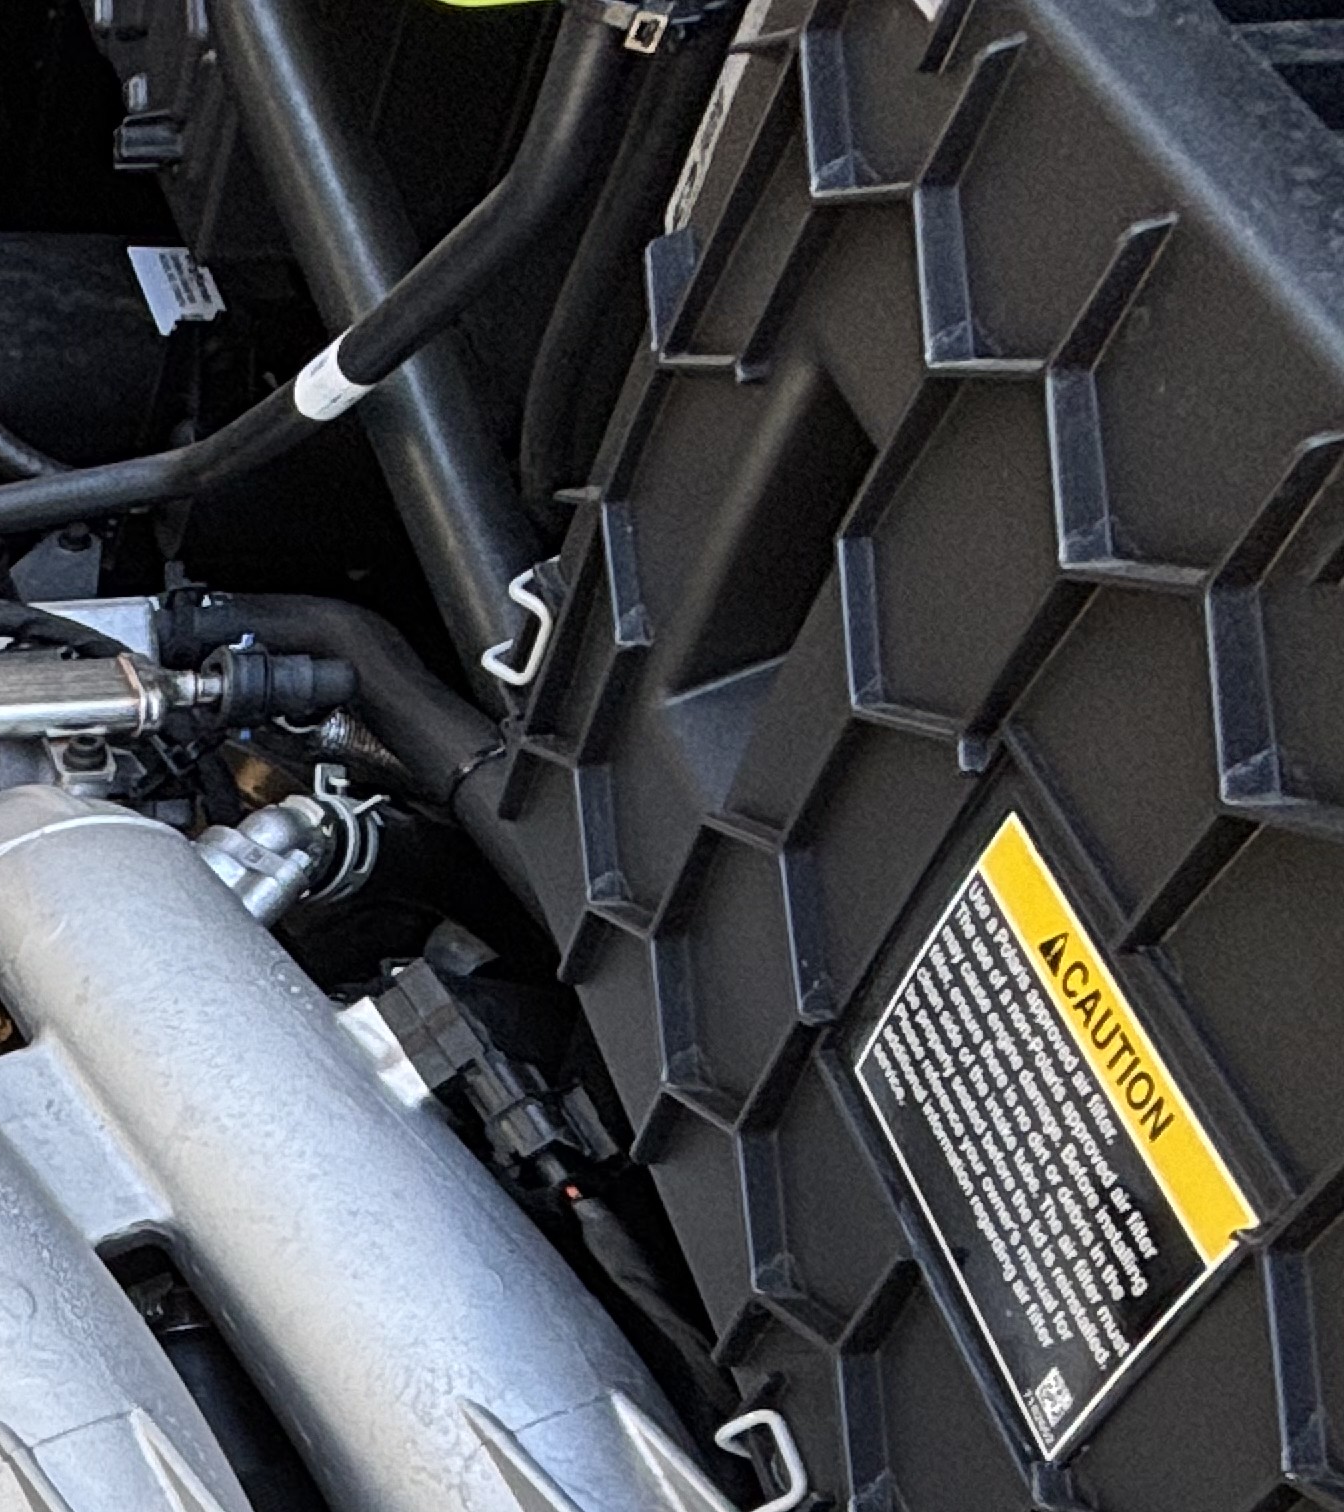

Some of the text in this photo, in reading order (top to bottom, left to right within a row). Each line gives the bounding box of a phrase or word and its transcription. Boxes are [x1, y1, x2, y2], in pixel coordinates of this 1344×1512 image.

[873, 1043, 905, 1105] service.
[905, 983, 920, 1010] be
[915, 1009, 956, 1077] properly
[952, 1075, 987, 1135] seated
[982, 1131, 1015, 1191] before
[1011, 1189, 1033, 1223] the
[1028, 1219, 1049, 1248] lid
[1041, 1245, 1055, 1267] is
[942, 925, 1147, 1296] may cause engine damage. Before installing
[950, 987, 983, 1044] ensure
[980, 1040, 1008, 1088] there
[1004, 1084, 1018, 1107] is
[1013, 1105, 1031, 1132] no
[1027, 1131, 1051, 1165] dirt
[1045, 1164, 1063, 1185] or
[1057, 1187, 1094, 1247] debris
[1090, 1242, 1106, 1267] in
[1102, 1265, 1124, 1301] the
[955, 901, 1157, 1258] The use of a non-Polaris approved air filter
[969, 881, 1117, 1145] Use a Polaris approved air filter.
[1063, 961, 1173, 1141] CAUTION
[917, 967, 944, 1013] clean
[939, 1011, 963, 1048] side
[959, 1047, 975, 1067] of
[969, 1065, 989, 1097] the
[985, 1092, 1017, 1151] intake
[1039, 1193, 1063, 1236] The
[1057, 1234, 1078, 1260] air
[1073, 1259, 1103, 1303] filter
[1097, 1305, 1130, 1357] must
[921, 1059, 965, 1137] reference
[959, 1135, 986, 1175] your
[982, 1177, 1021, 1246] owner's
[1017, 1245, 1059, 1313] manual
[1052, 1311, 1074, 1341] for
[923, 1099, 974, 1196] information
[969, 1195, 1017, 1281] regarding
[1012, 1279, 1031, 1305] air
[1025, 1303, 1055, 1348] filter
